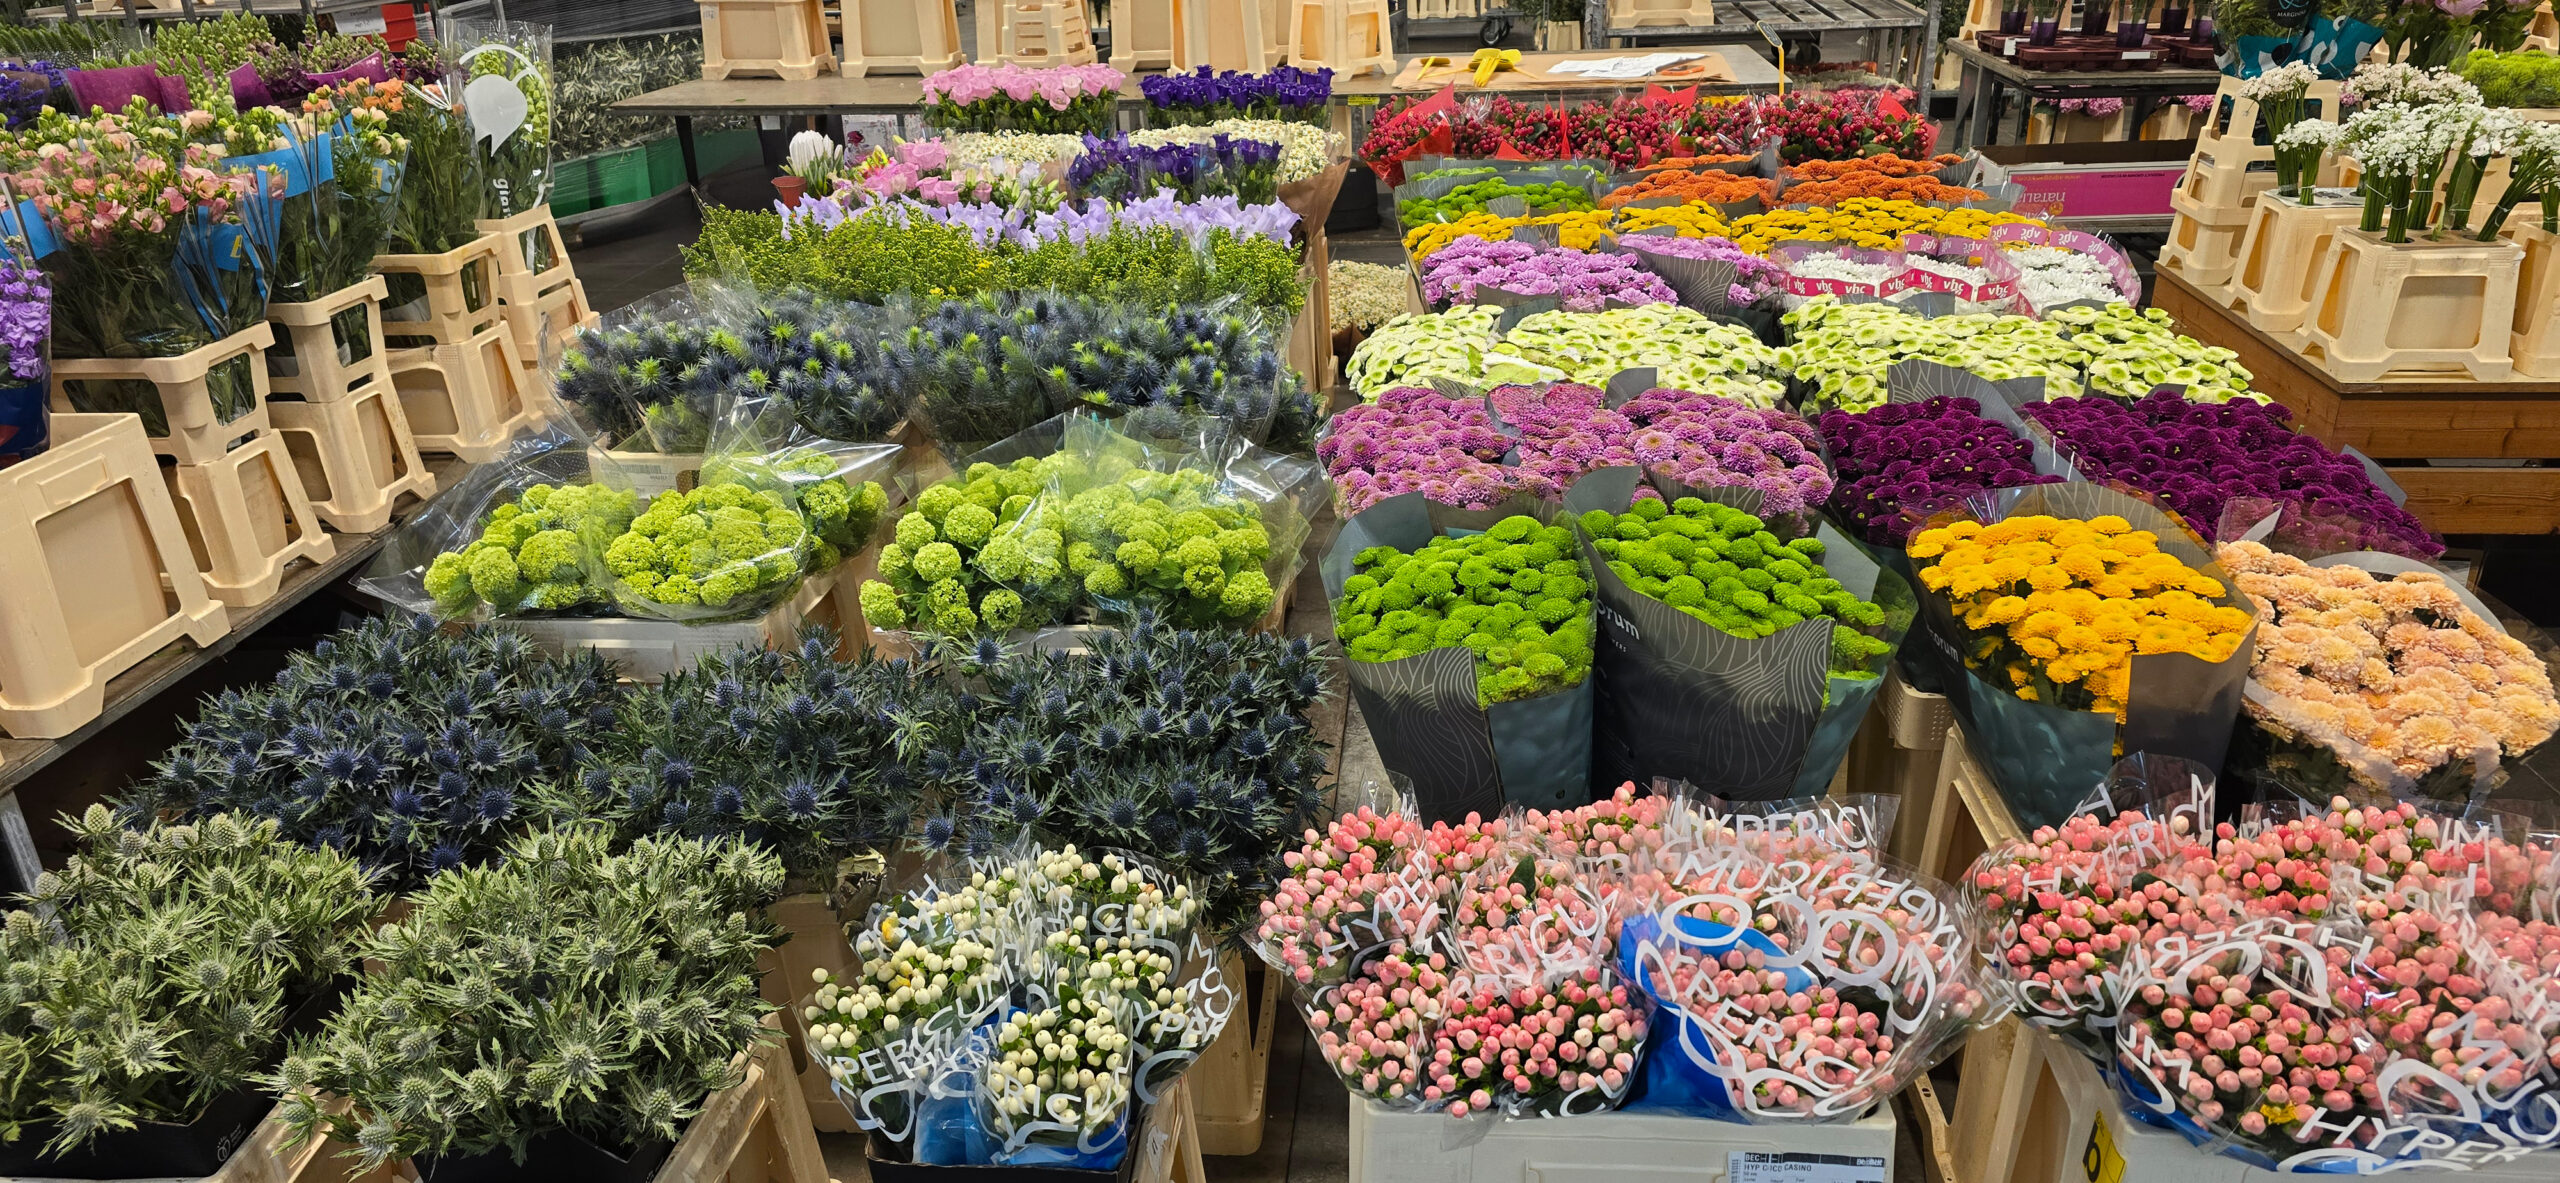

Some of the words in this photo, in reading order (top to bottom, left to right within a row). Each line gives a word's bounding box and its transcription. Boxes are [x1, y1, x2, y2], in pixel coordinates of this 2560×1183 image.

[1816, 281, 1833, 293] vbc
[1845, 283, 1866, 294] vbc
[1943, 279, 1965, 293] vbc
[1988, 284, 2009, 296] vbc
[1783, 1164, 1812, 1172] CASINO
